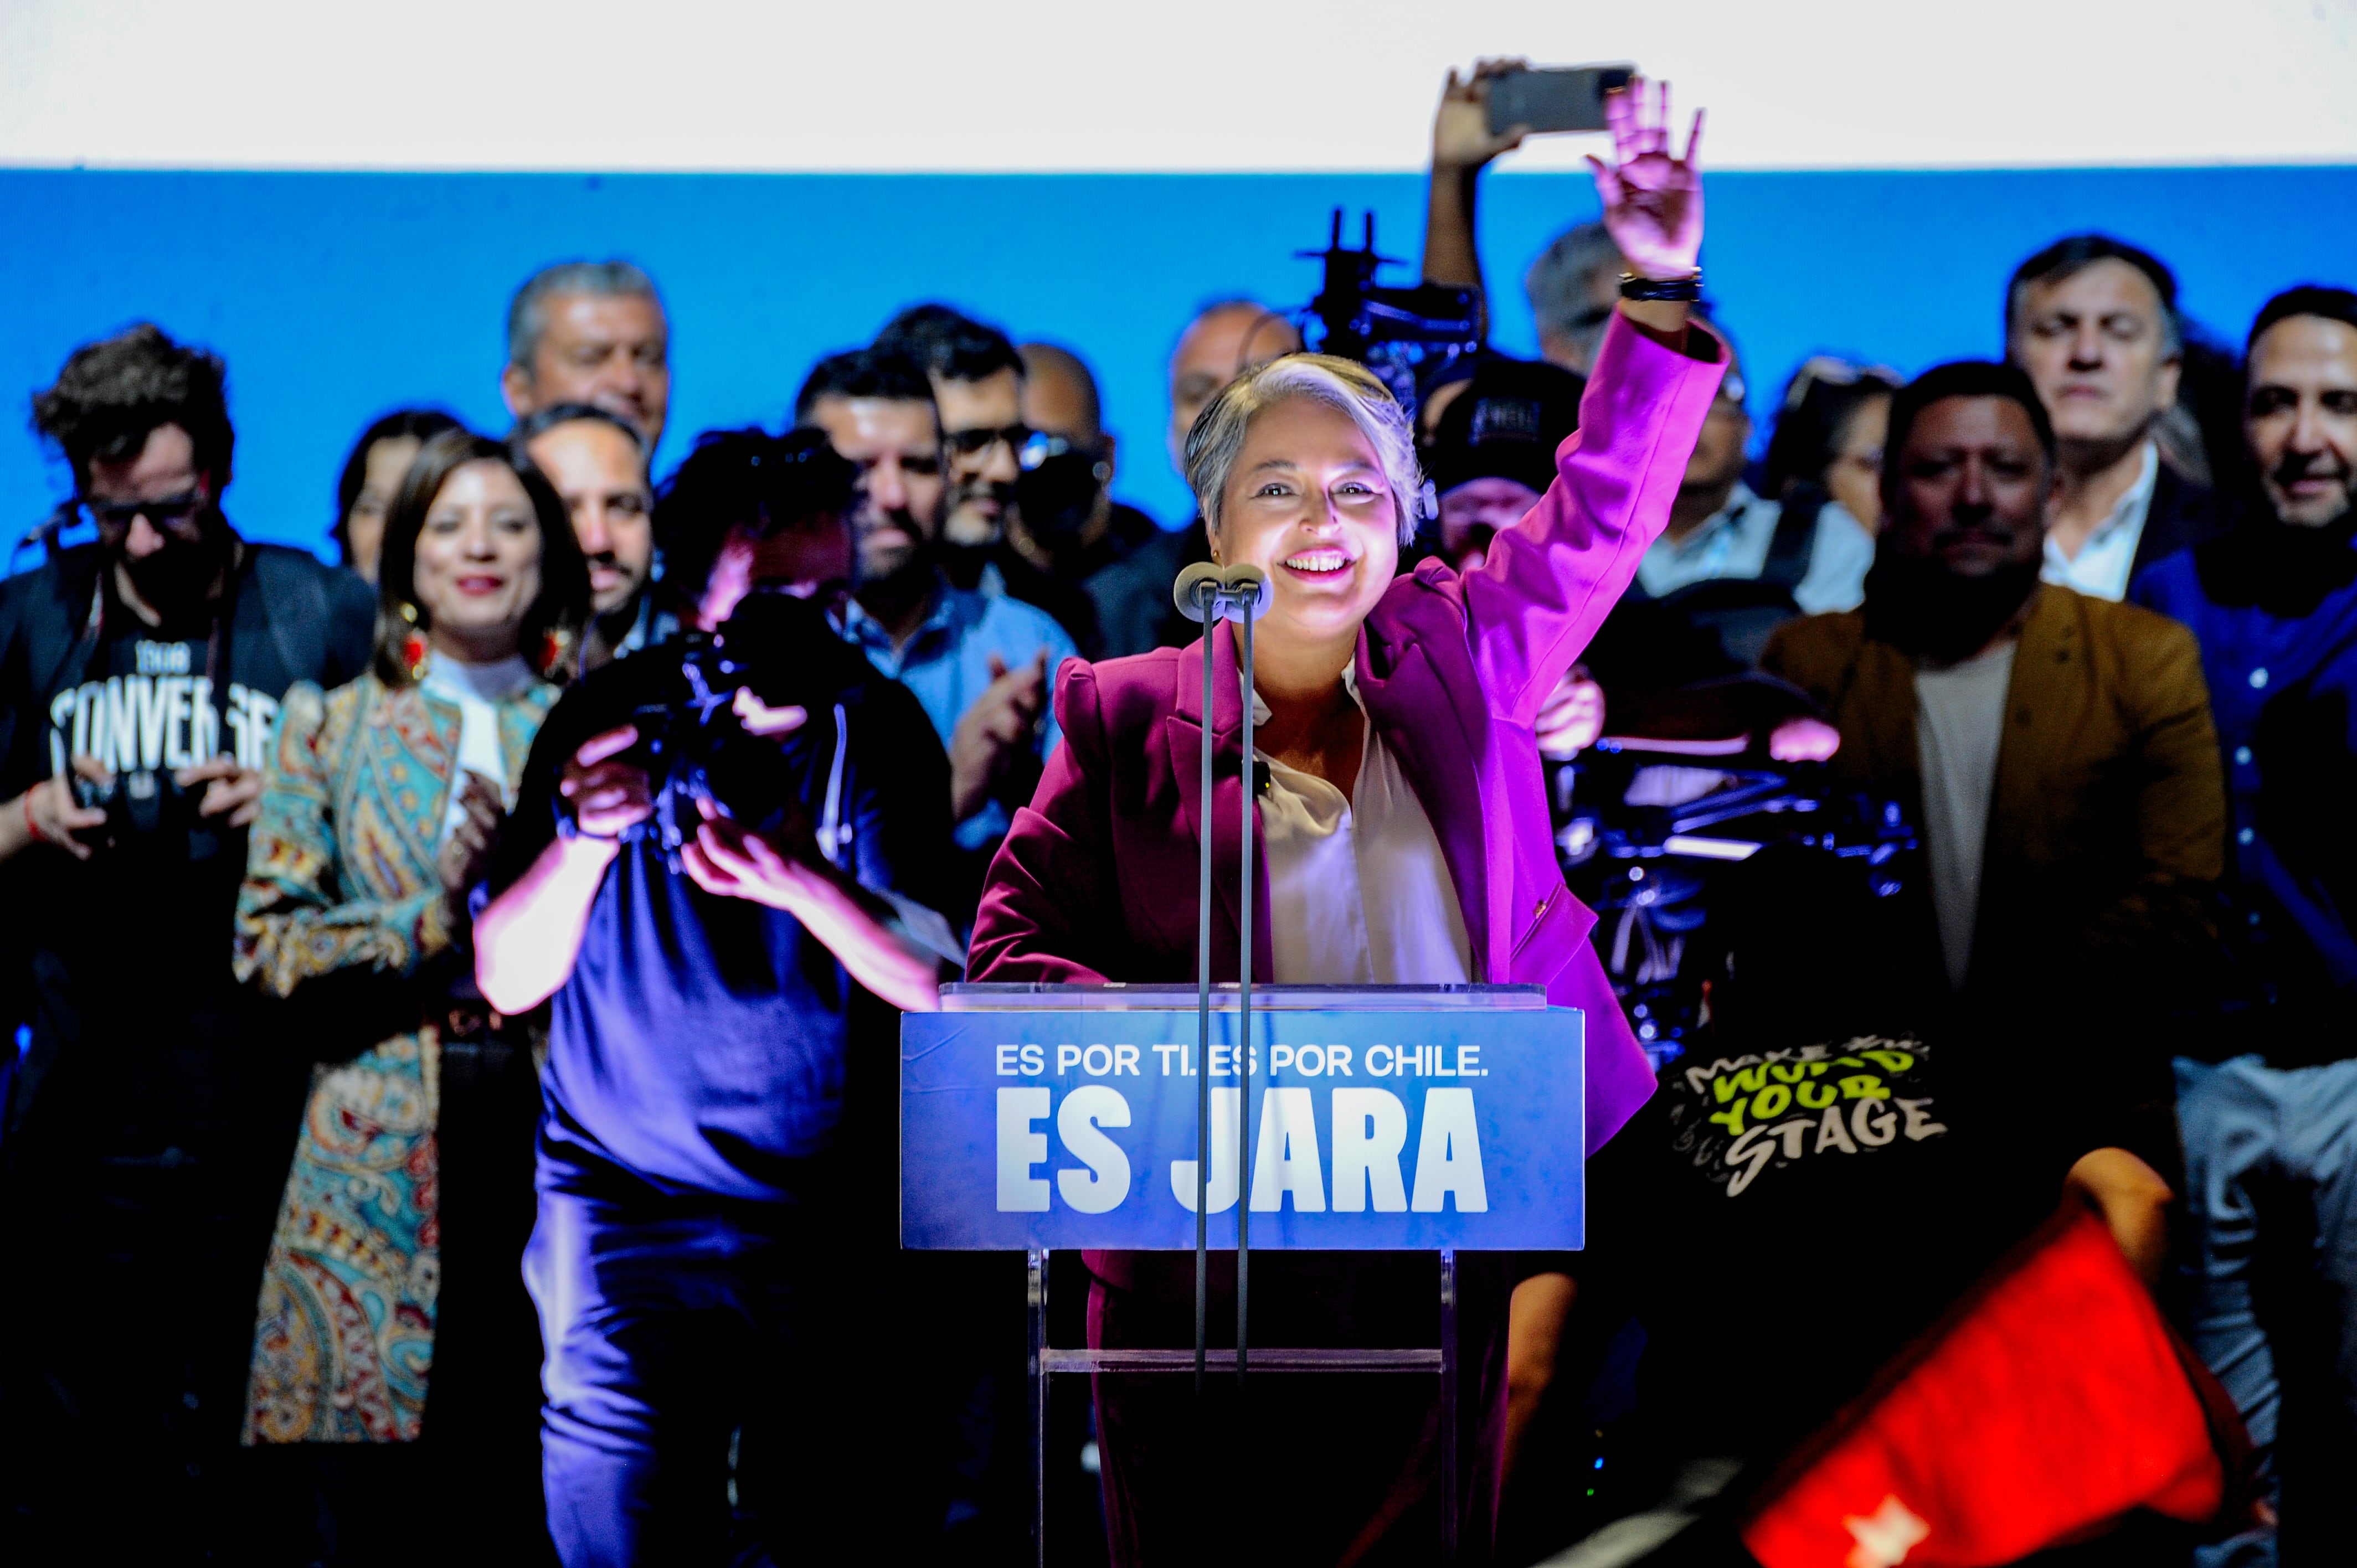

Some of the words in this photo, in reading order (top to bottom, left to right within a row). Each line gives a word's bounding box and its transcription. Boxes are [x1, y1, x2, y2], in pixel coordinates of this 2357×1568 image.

[996, 1044, 1044, 1076] ES
[1057, 1044, 1140, 1076] POR
[1152, 1044, 1197, 1076] TI.
[1208, 1044, 1257, 1076] ES
[1270, 1044, 1353, 1076] POR
[1365, 1044, 1488, 1076] CHILE.
[1708, 1074, 1891, 1136] YOUR
[996, 1085, 1131, 1214] ES
[1171, 1086, 1488, 1214] JARA
[1724, 1096, 1947, 1197] STAGE
